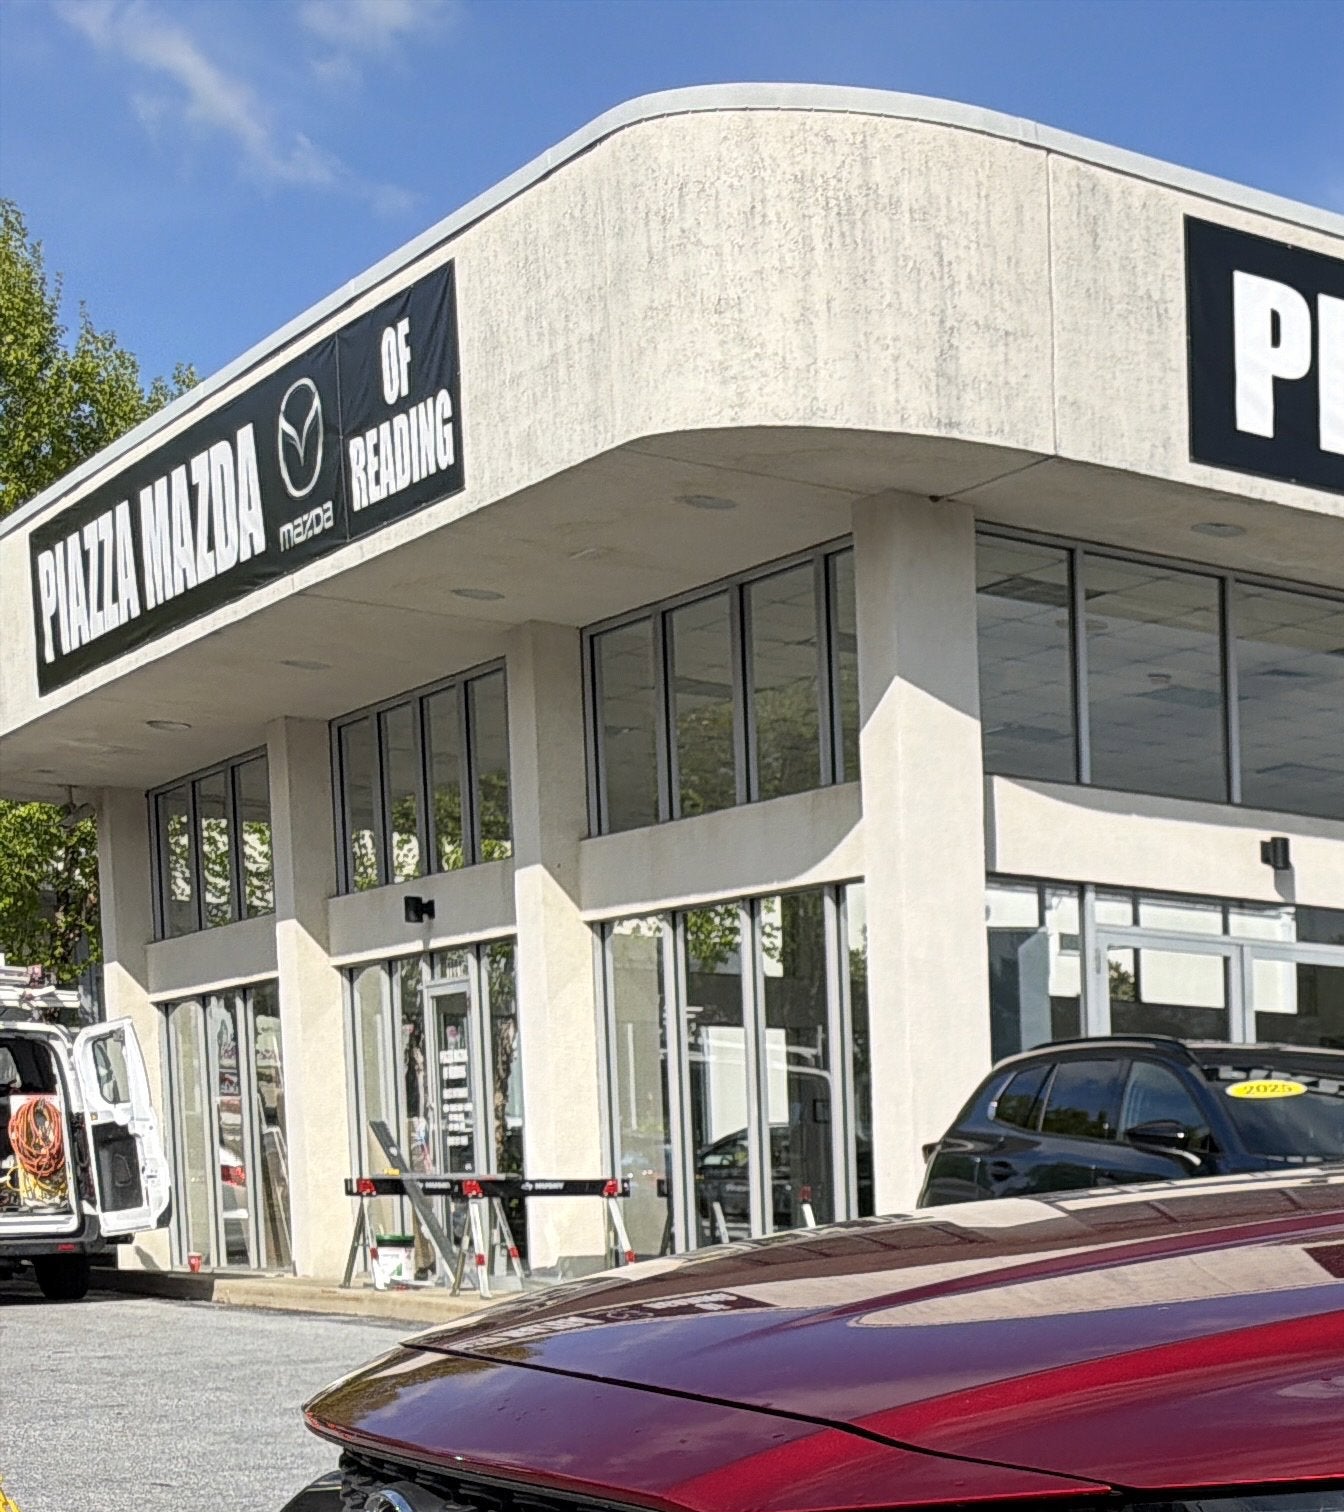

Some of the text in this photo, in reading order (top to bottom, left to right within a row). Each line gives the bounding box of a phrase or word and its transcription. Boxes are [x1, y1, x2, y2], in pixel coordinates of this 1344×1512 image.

[381, 317, 411, 405] OF
[350, 389, 455, 513] READING
[38, 423, 266, 664] PIAZZA MAZDA
[279, 501, 334, 552] mazda
[1243, 1083, 1293, 1095] 2025
